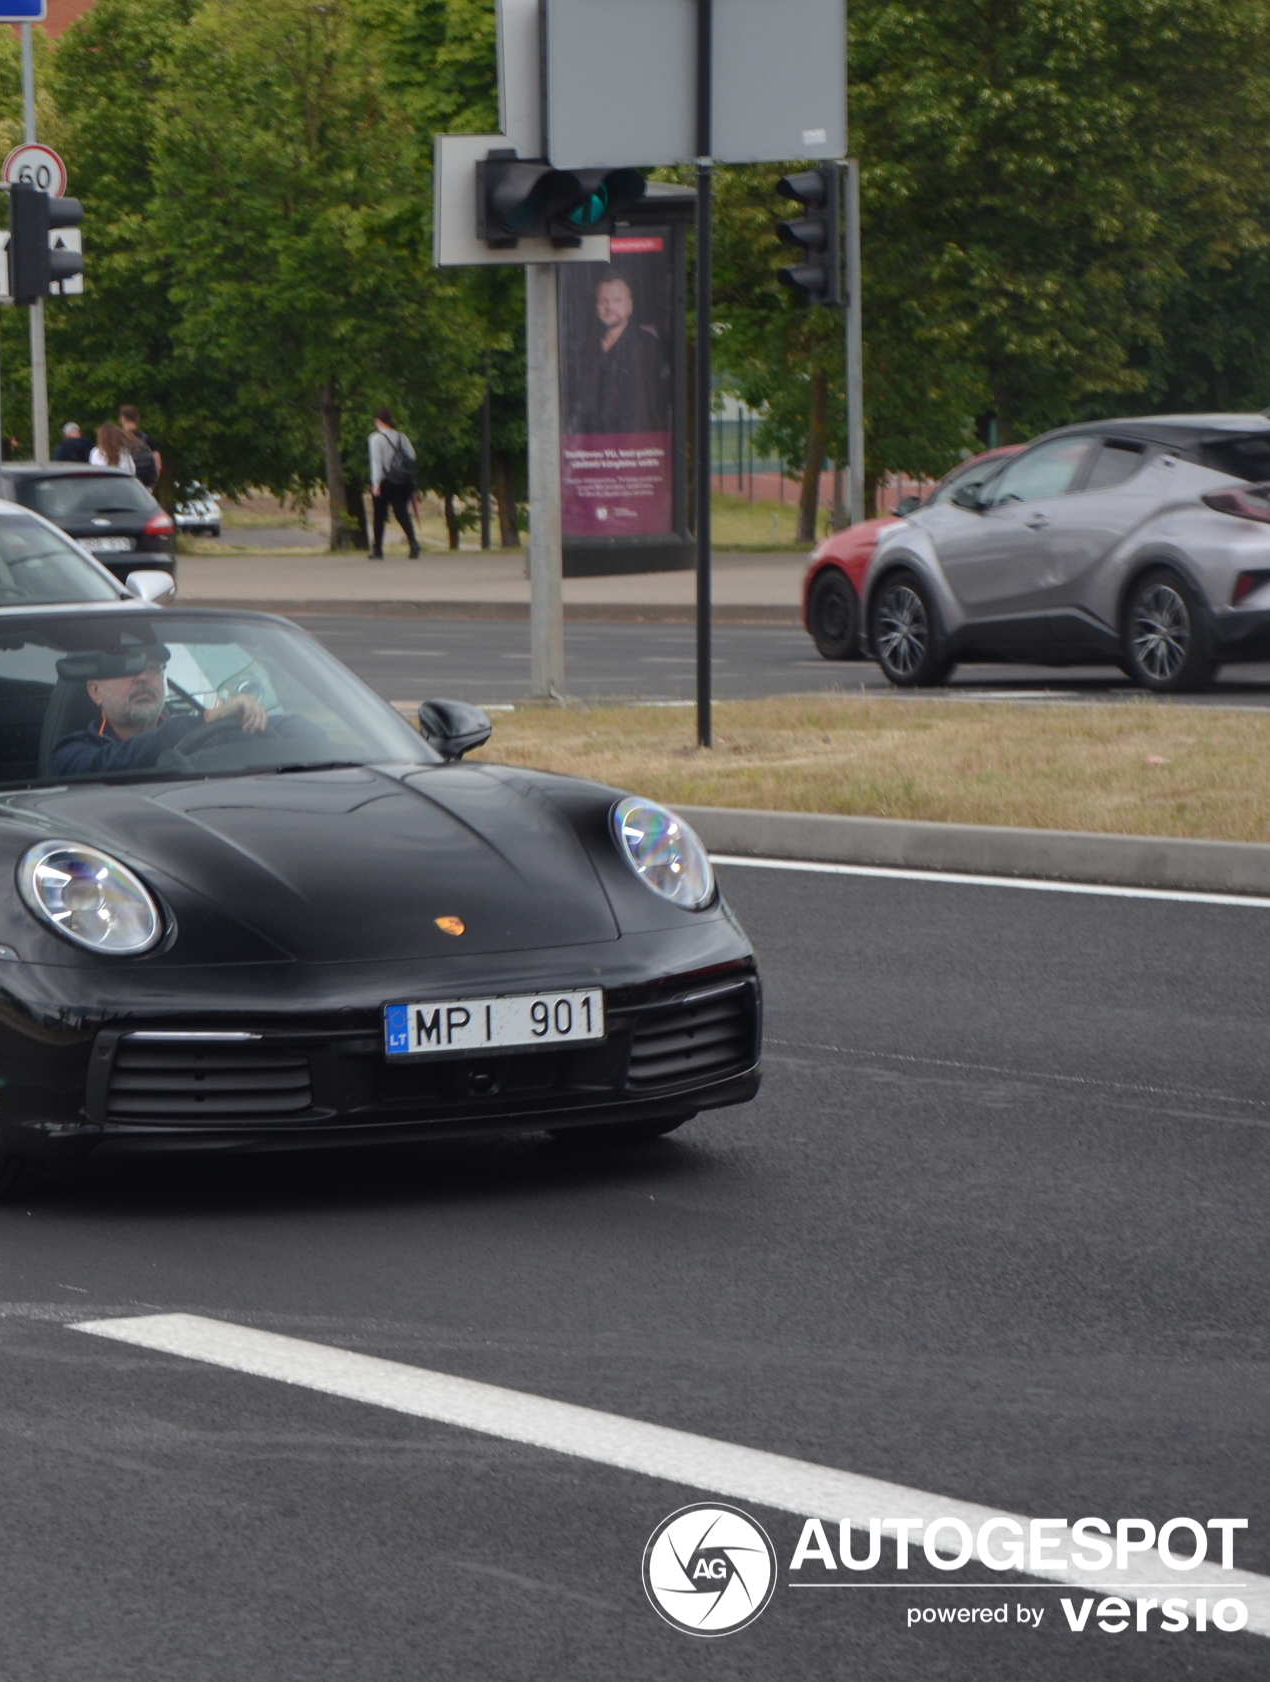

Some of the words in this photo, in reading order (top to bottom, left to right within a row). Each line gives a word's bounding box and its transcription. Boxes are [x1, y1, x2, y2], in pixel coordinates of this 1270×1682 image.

[19, 165, 50, 189] 60
[415, 1004, 491, 1046] MPI
[530, 996, 592, 1037] 901
[389, 1034, 407, 1047] LT
